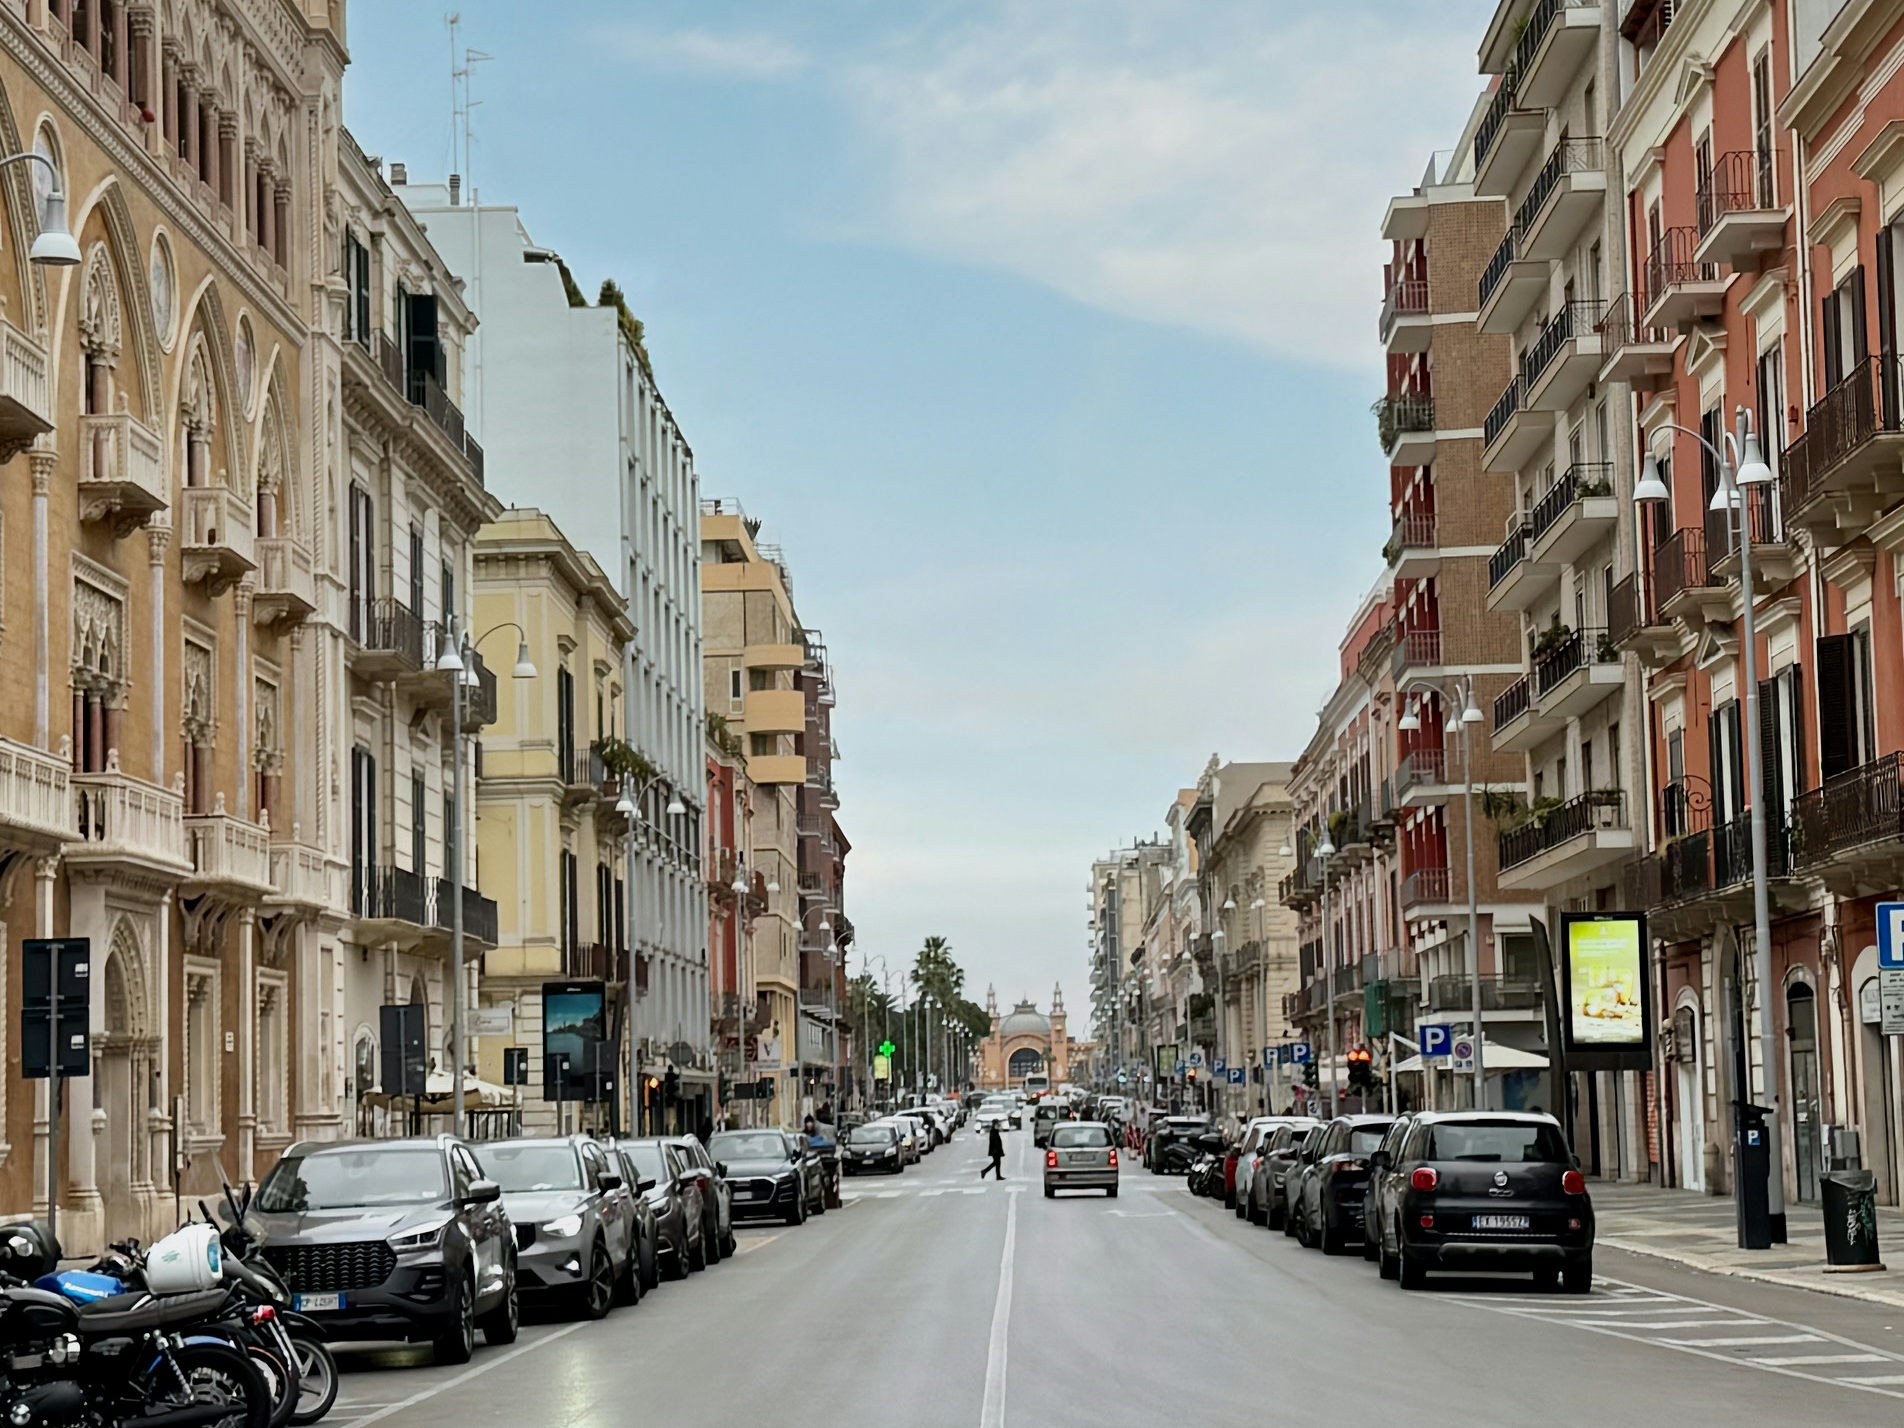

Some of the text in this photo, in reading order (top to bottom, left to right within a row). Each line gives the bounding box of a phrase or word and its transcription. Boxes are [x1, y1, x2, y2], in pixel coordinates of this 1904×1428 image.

[1425, 1027, 1445, 1053] P
[1293, 1044, 1308, 1062] P
[1213, 1059, 1224, 1072] P
[1229, 1070, 1240, 1083] P
[1747, 1129, 1759, 1145] P
